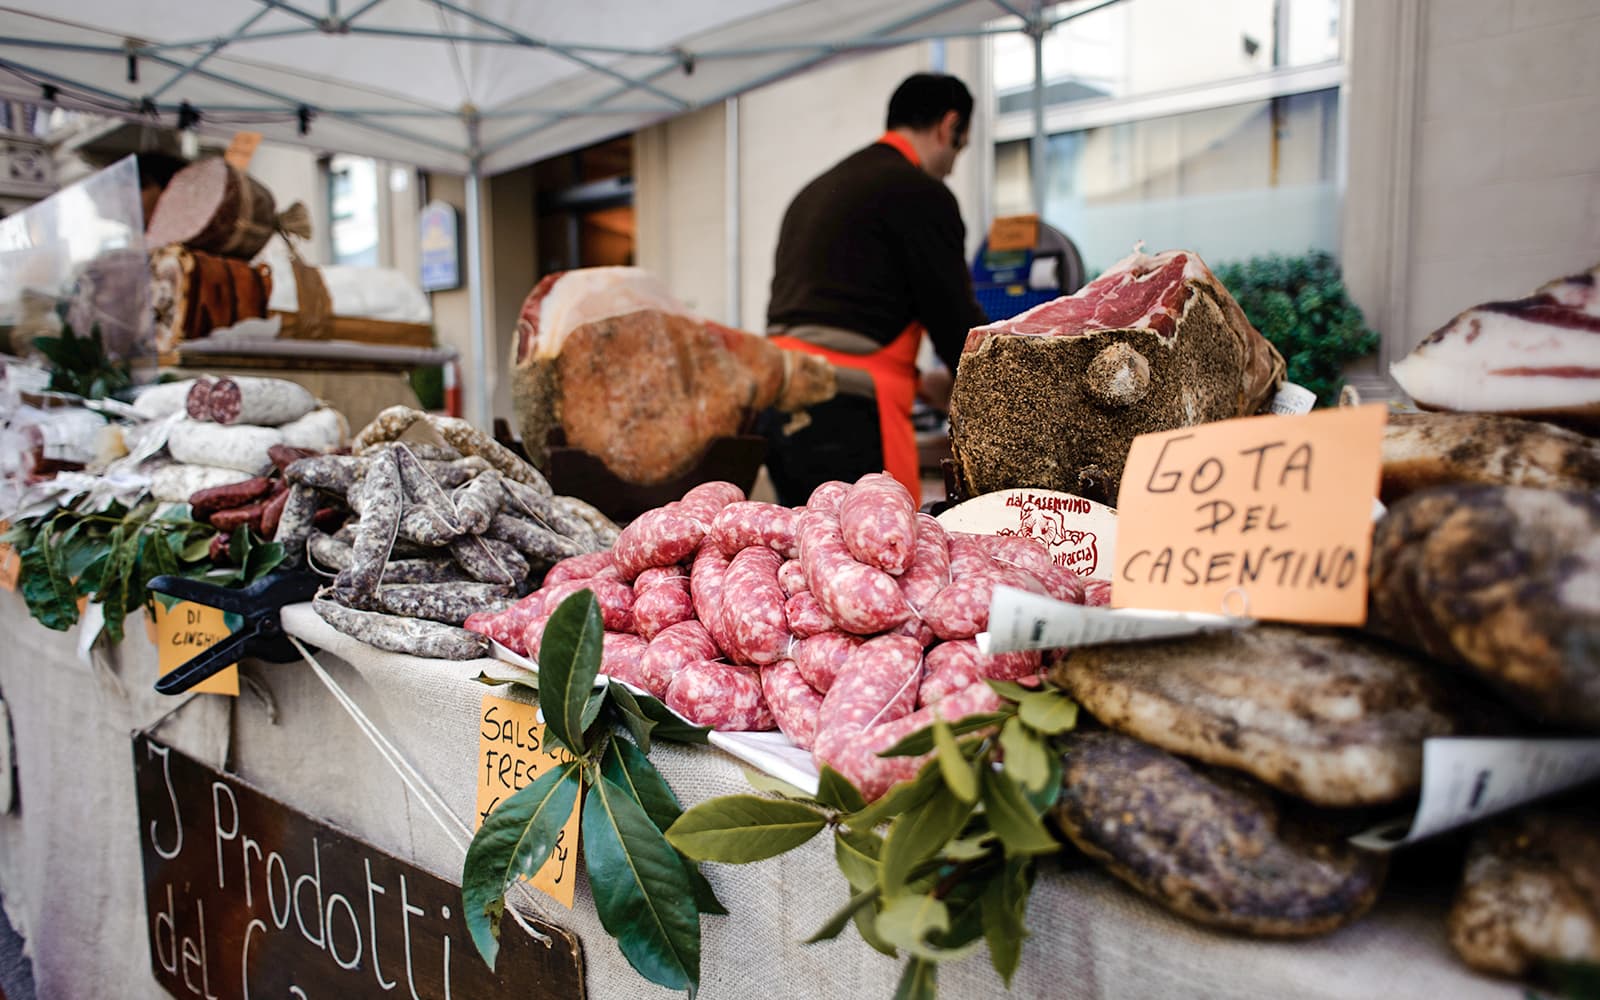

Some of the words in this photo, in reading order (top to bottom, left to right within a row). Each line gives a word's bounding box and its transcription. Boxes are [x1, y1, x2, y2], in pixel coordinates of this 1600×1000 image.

[1146, 434, 1313, 494] GOTA
[1195, 499, 1289, 534] DEL
[1122, 545, 1357, 589] CASENTINO
[187, 609, 201, 625] DI
[486, 750, 538, 791] FRES
[212, 782, 451, 1000] Prodotti
[155, 883, 218, 1000] del
